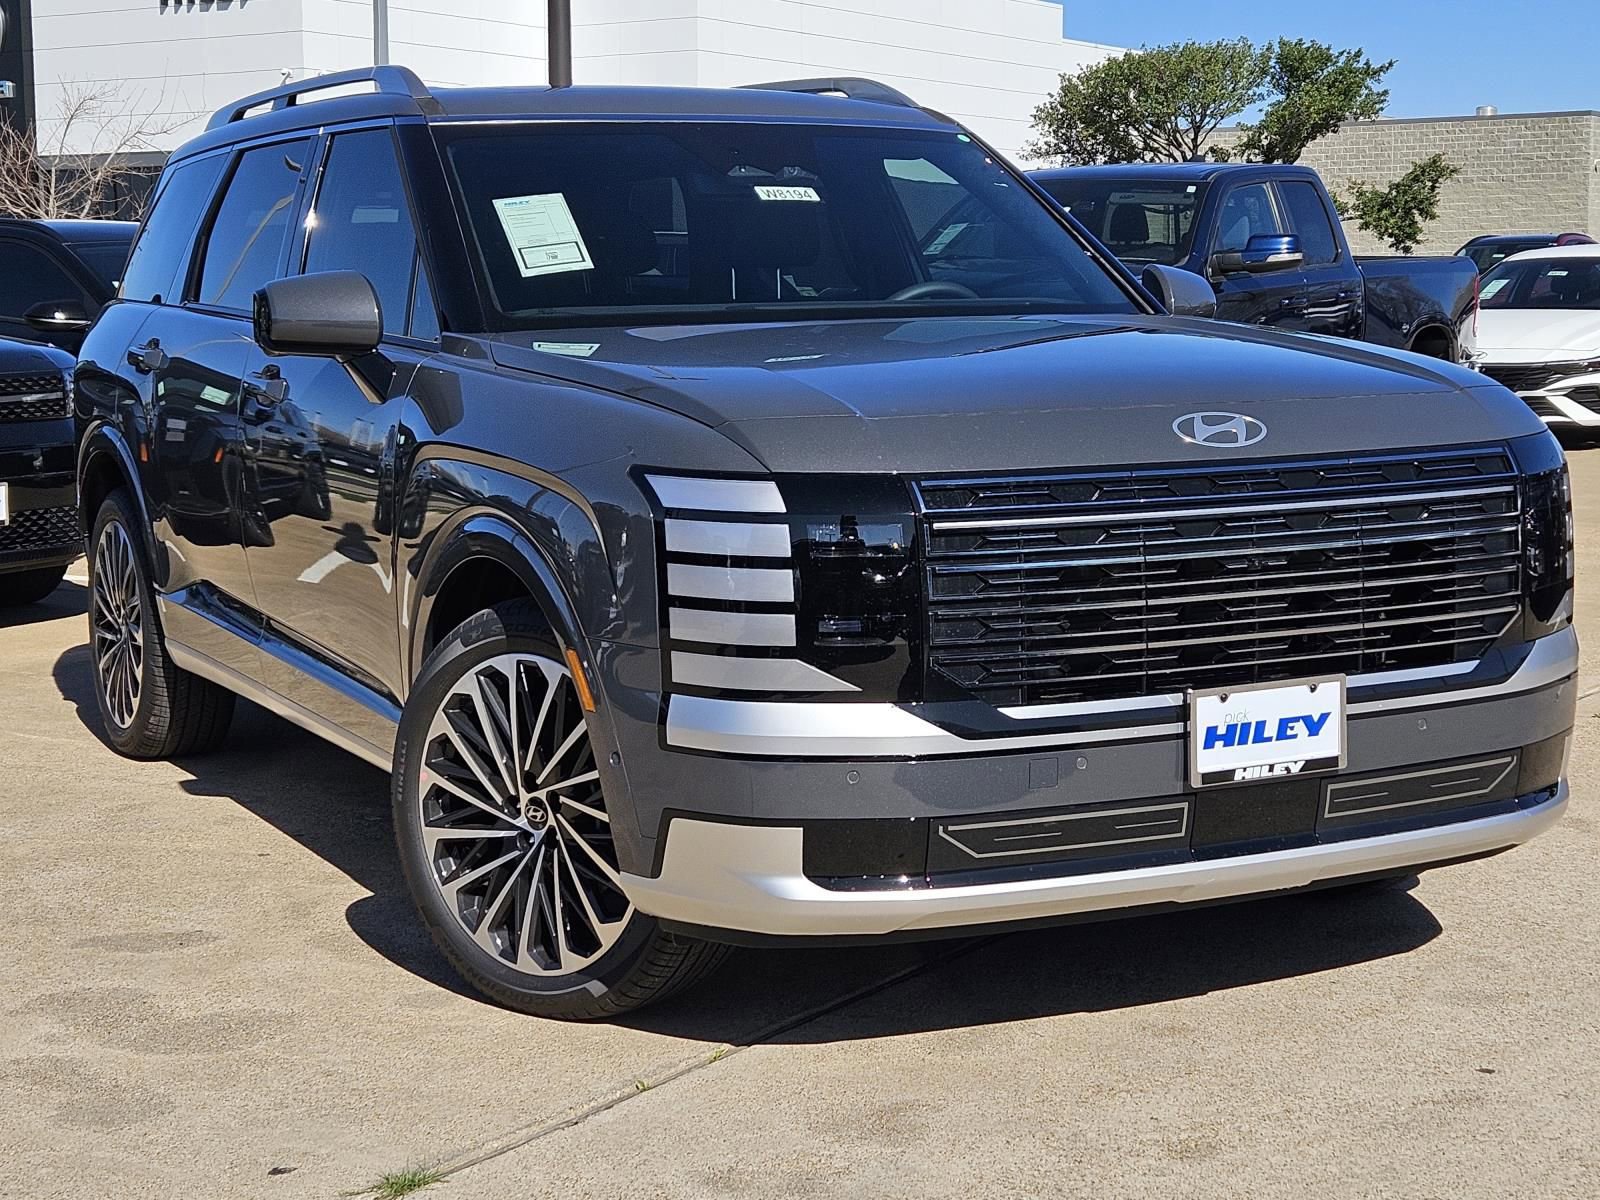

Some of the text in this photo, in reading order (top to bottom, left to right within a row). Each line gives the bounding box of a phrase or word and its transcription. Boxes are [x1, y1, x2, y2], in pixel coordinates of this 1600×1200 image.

[759, 188, 813, 200] W8194
[1203, 711, 1332, 750] HILEY
[1234, 760, 1306, 781] HILEY
